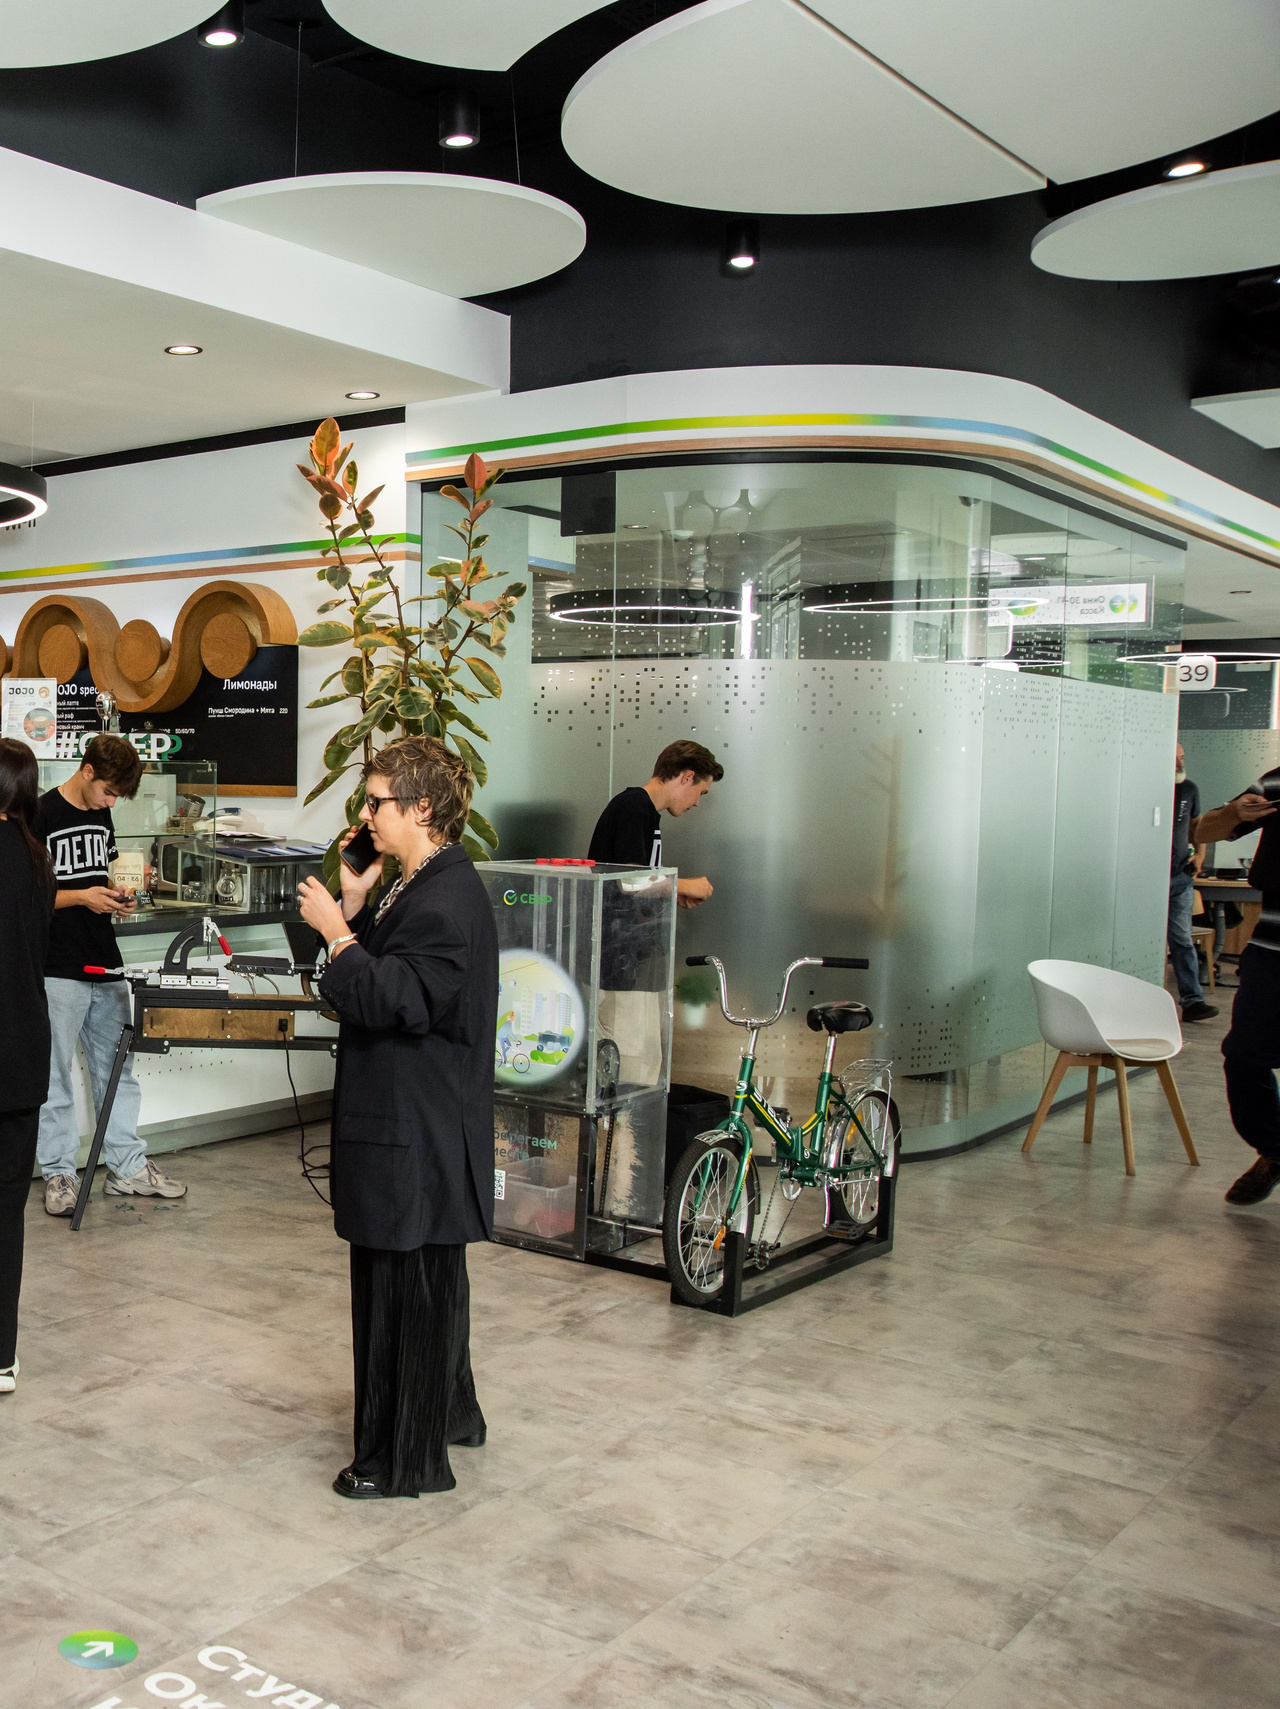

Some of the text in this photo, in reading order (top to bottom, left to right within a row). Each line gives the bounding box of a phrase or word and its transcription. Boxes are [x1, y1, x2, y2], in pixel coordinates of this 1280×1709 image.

[1179, 664, 1209, 682] 39
[8, 687, 35, 695] JOJO
[57, 684, 99, 697] OJO spec
[223, 679, 277, 691] Лимонады
[224, 707, 255, 715] Смородина
[494, 1127, 558, 1151] берегаем
[197, 1645, 340, 1709] Студ
